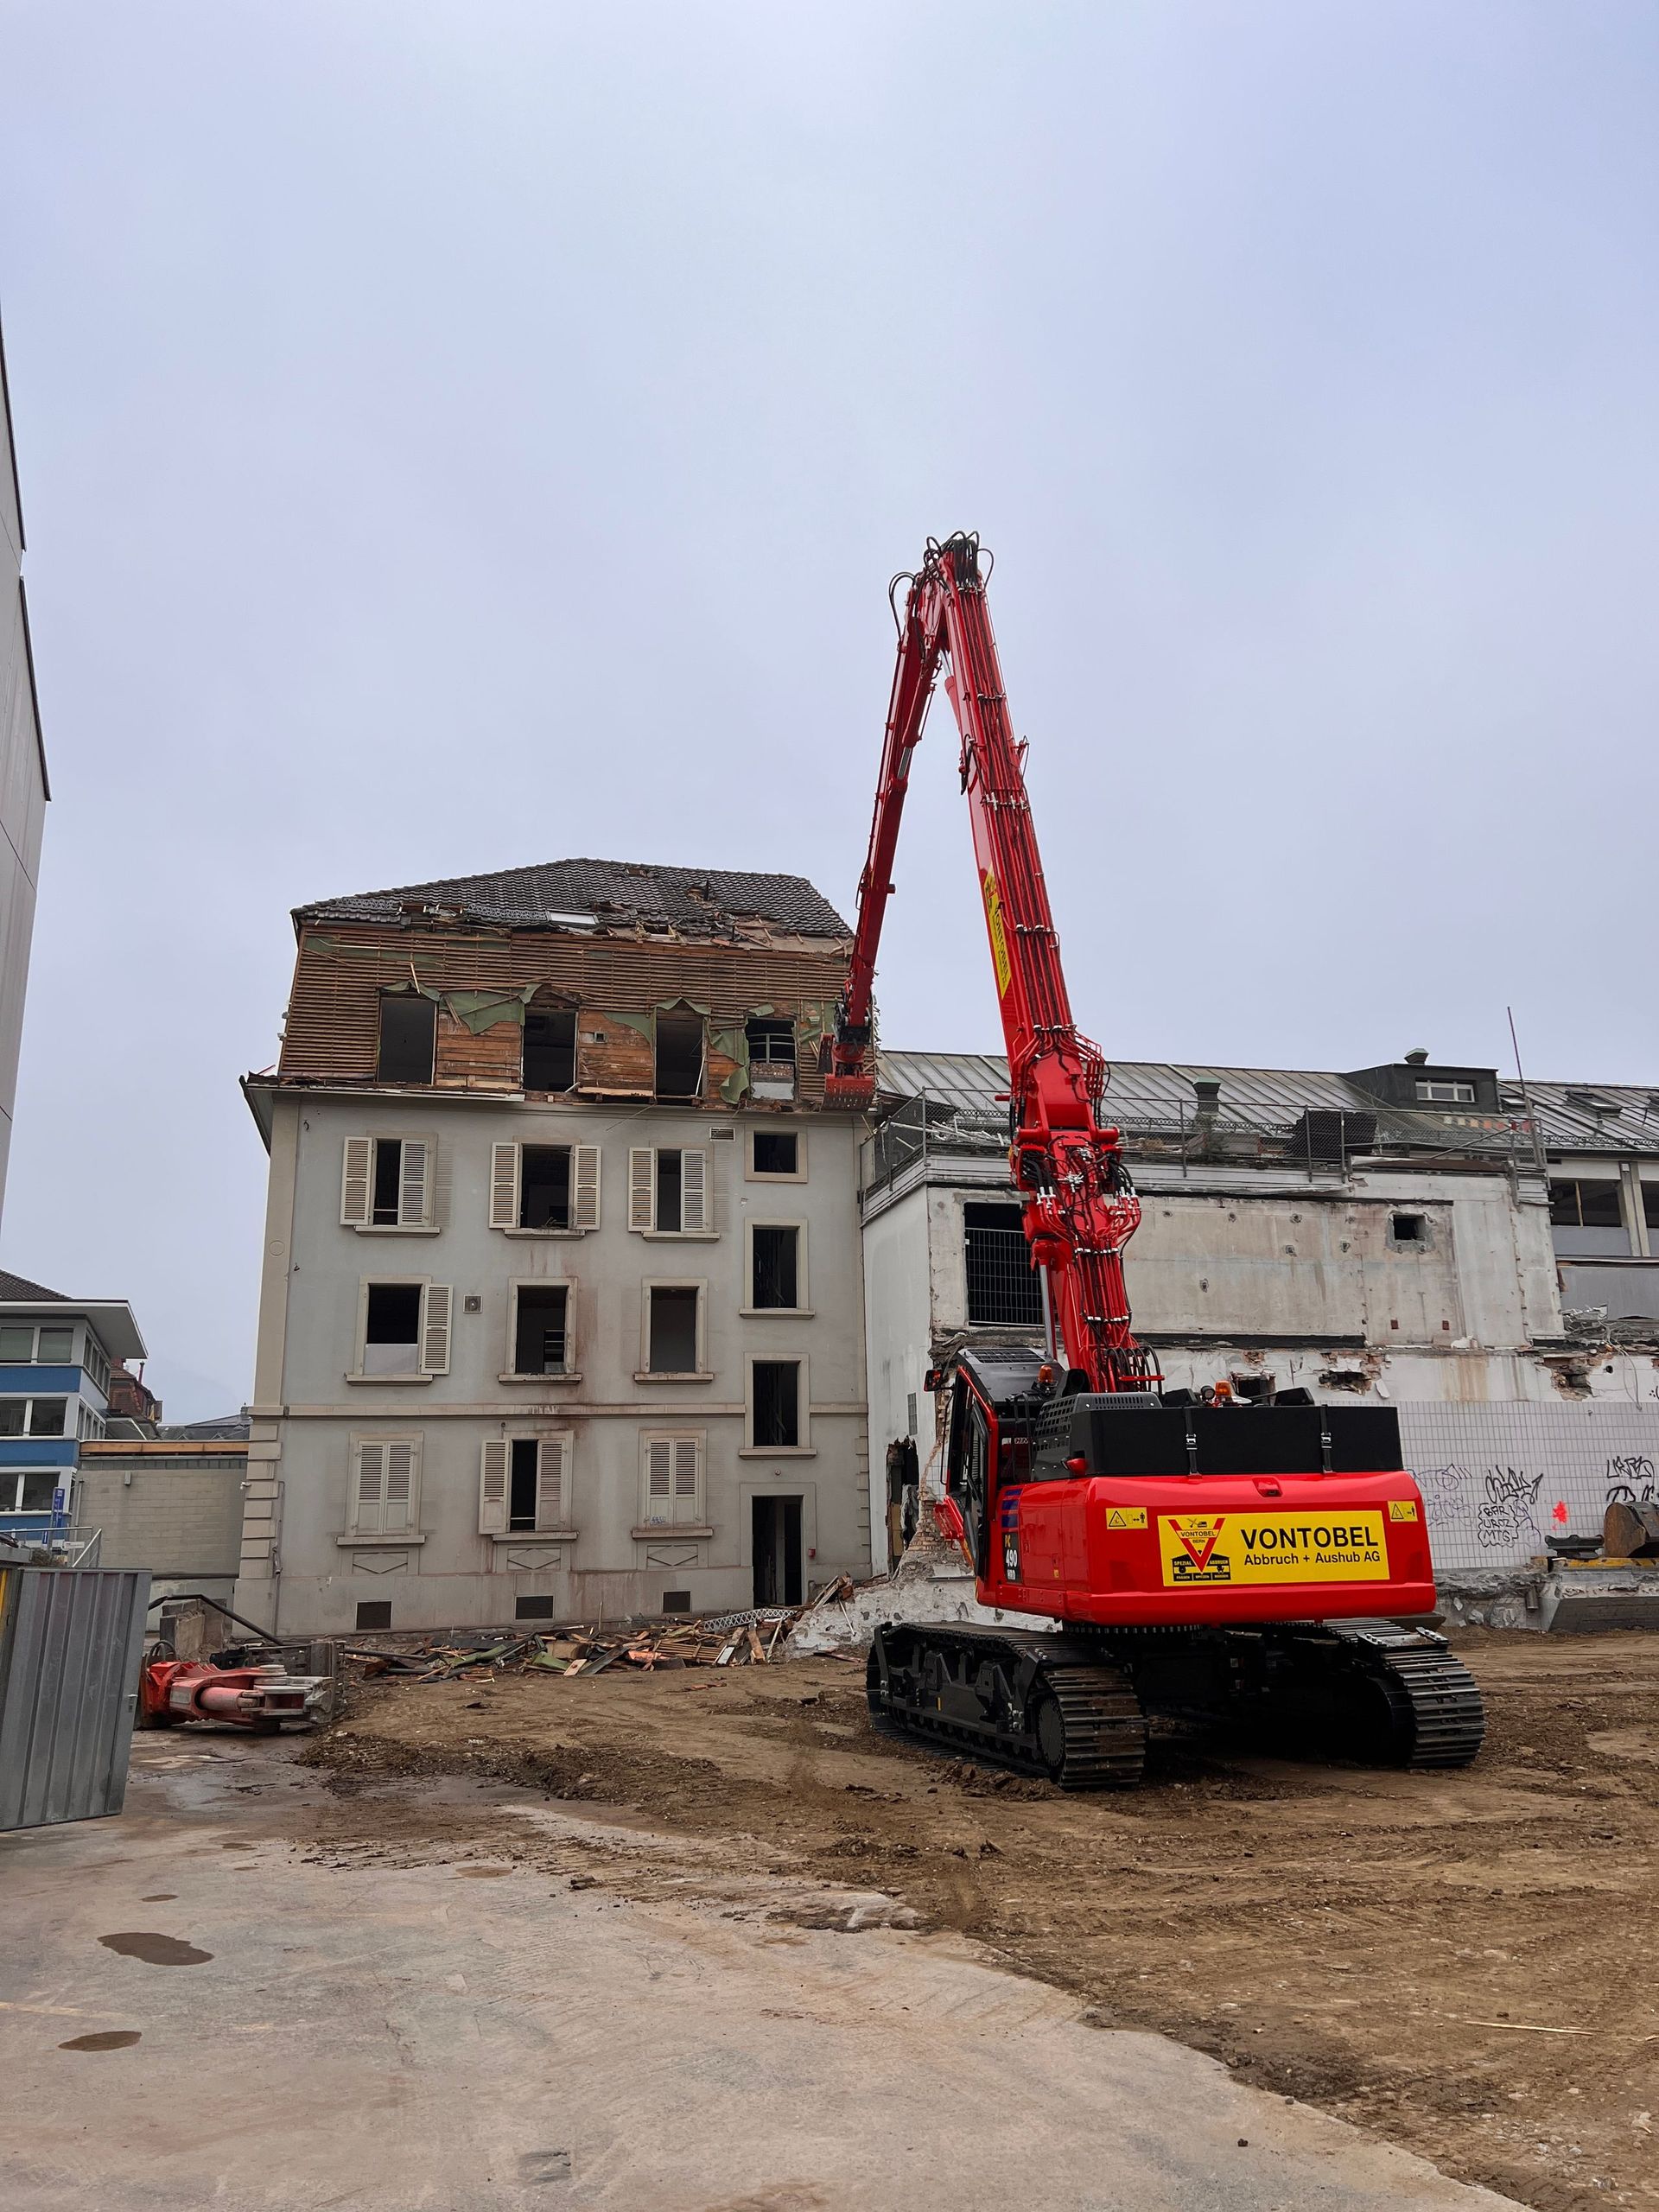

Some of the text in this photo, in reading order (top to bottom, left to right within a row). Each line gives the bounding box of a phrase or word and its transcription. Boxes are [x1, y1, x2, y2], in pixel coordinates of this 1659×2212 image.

[1241, 1527, 1378, 1549] VONTOBEL
[1006, 1549, 1018, 1567] 490
[1244, 1553, 1299, 1565] Abbruch
[1315, 1552, 1360, 1563] Aushub
[1363, 1551, 1380, 1561] AG
